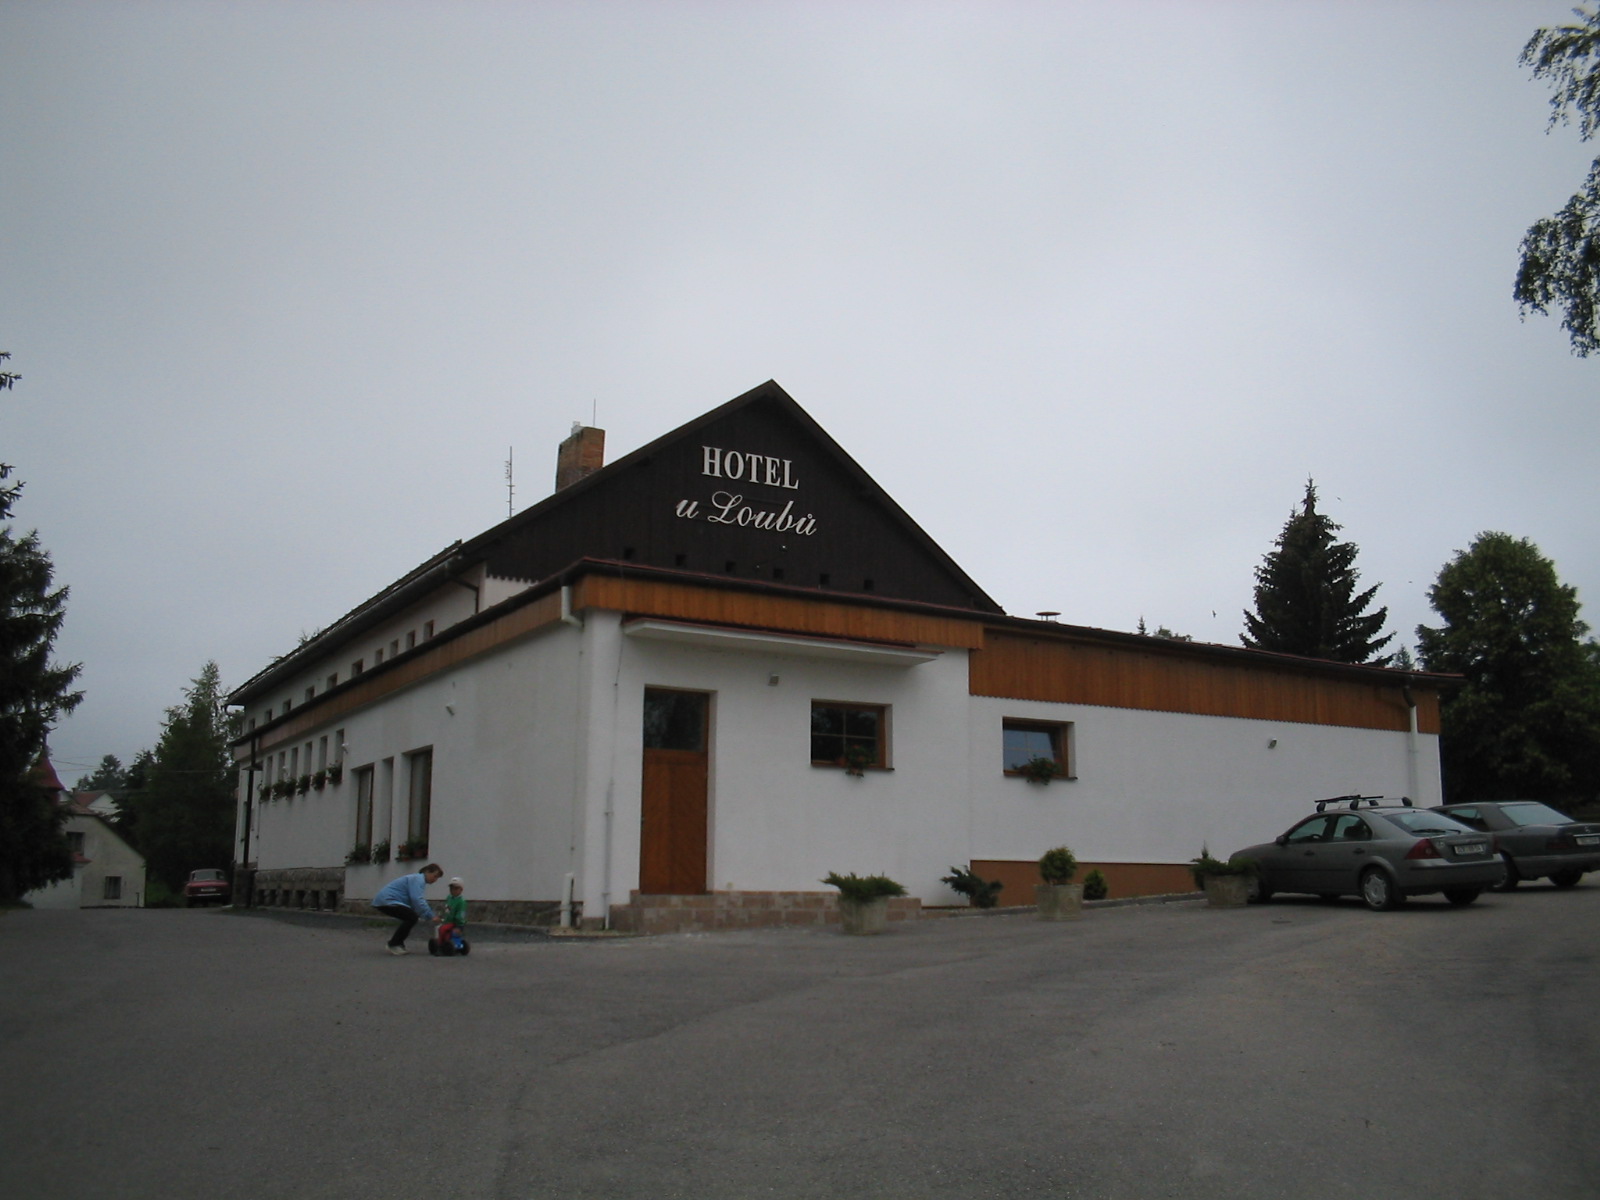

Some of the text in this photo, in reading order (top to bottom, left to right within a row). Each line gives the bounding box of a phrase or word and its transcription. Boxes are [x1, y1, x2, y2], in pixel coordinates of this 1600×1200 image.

[702, 445, 799, 490] HOTEL
[675, 490, 817, 536] u Loubů
